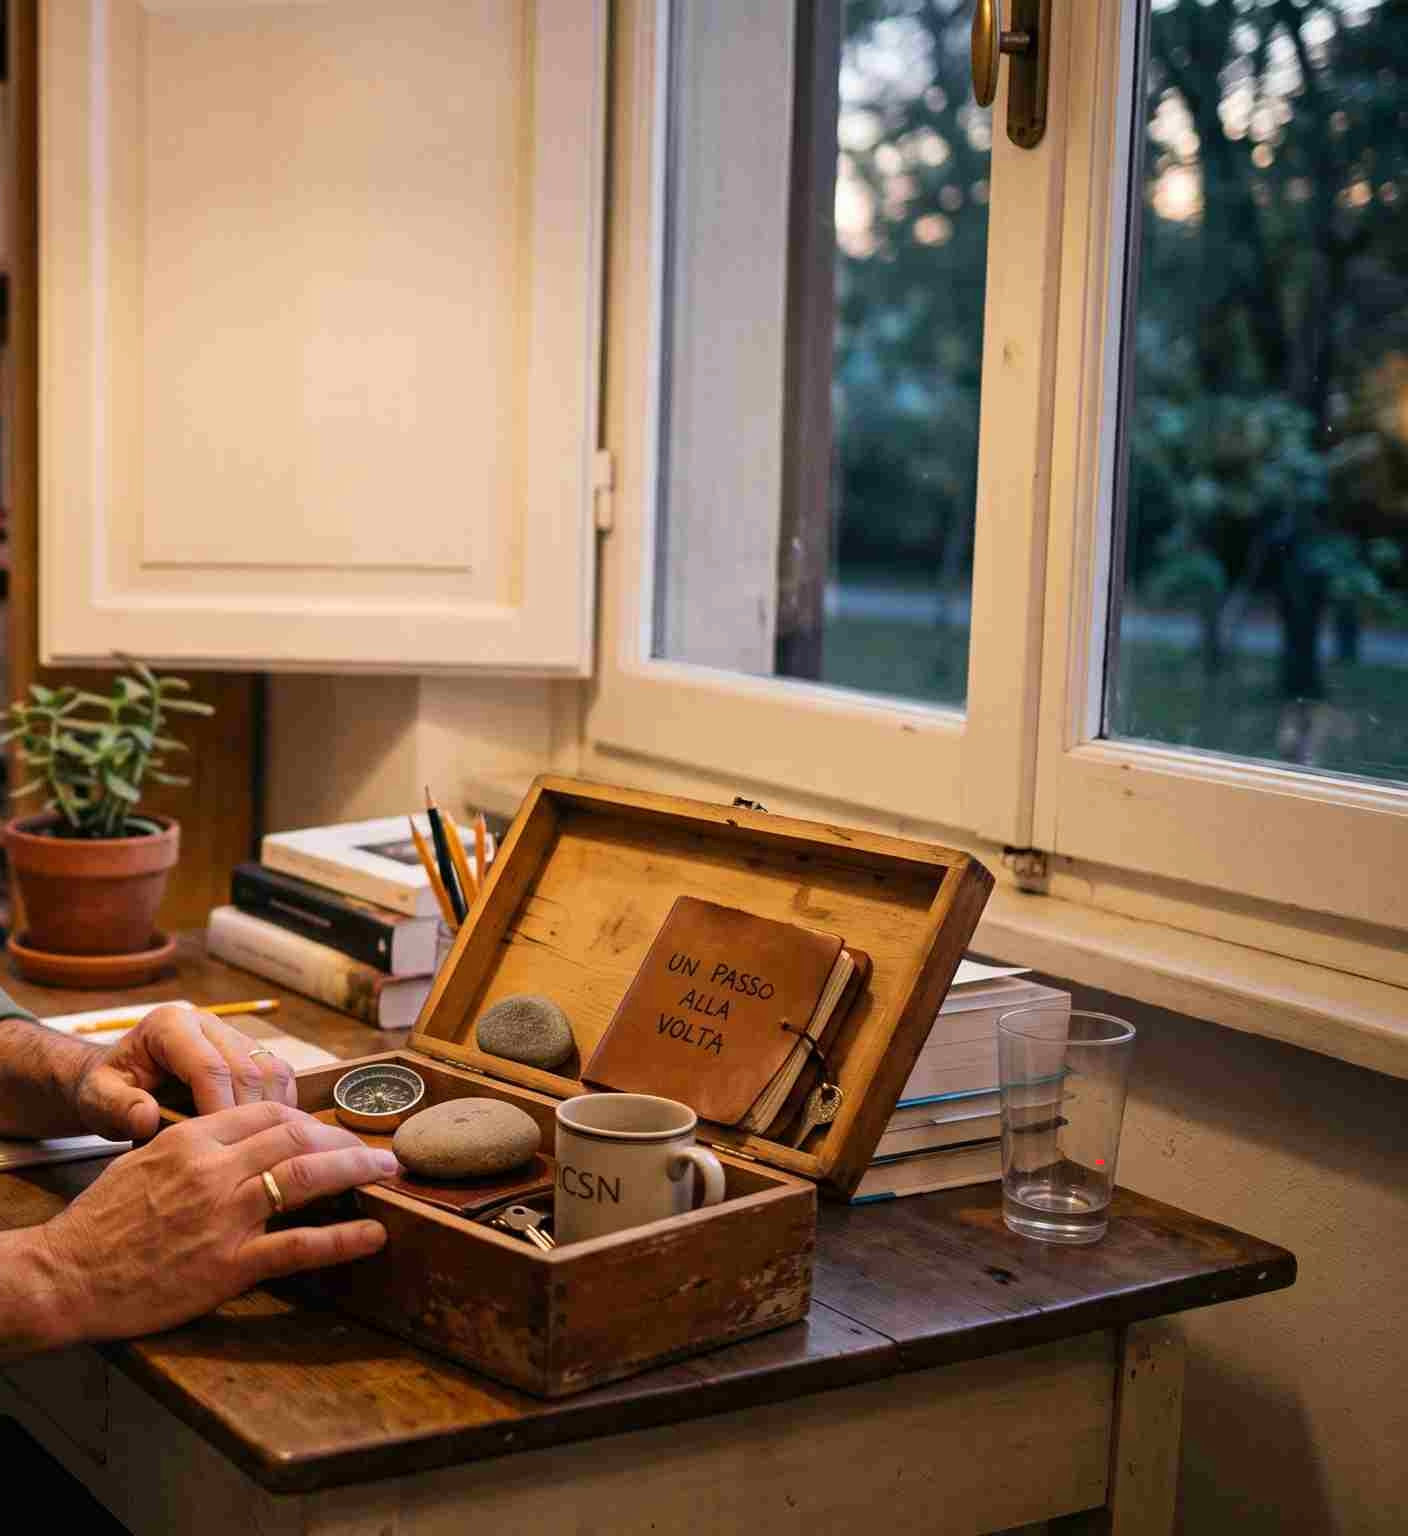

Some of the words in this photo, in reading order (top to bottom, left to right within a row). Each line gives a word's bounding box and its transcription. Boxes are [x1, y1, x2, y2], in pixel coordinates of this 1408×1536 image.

[668, 953, 701, 977] UN
[710, 963, 774, 1000] PASSO
[678, 989, 729, 1021] ALLA
[657, 1013, 723, 1054] VOLTA
